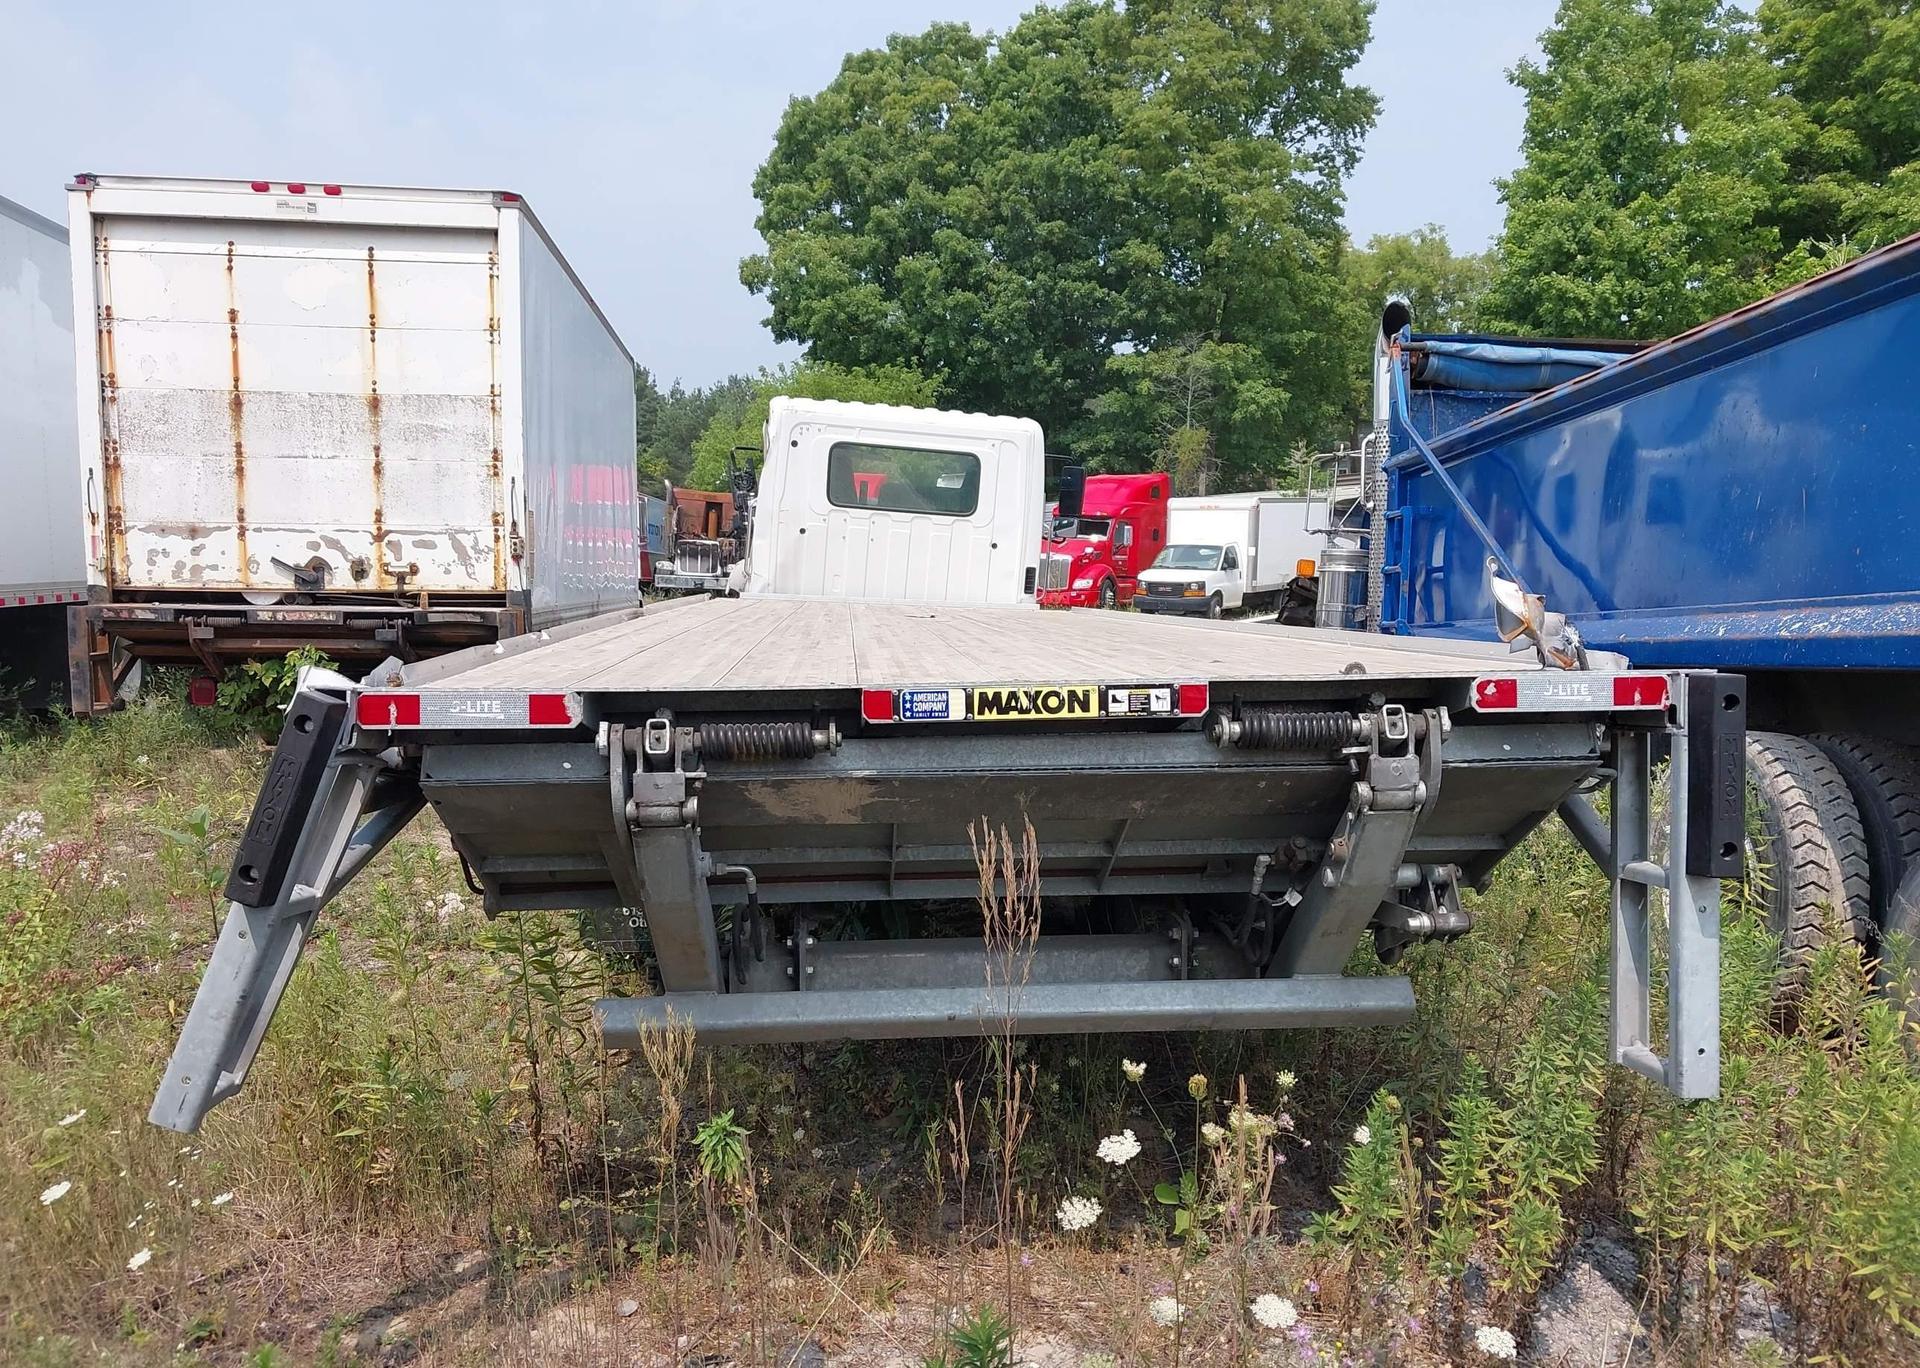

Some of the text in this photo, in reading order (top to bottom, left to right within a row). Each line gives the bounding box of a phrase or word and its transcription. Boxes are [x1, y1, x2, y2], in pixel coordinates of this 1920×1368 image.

[913, 692, 947, 702] AMERICAN
[977, 689, 1090, 715] MAXON
[913, 701, 947, 711] COMPANY
